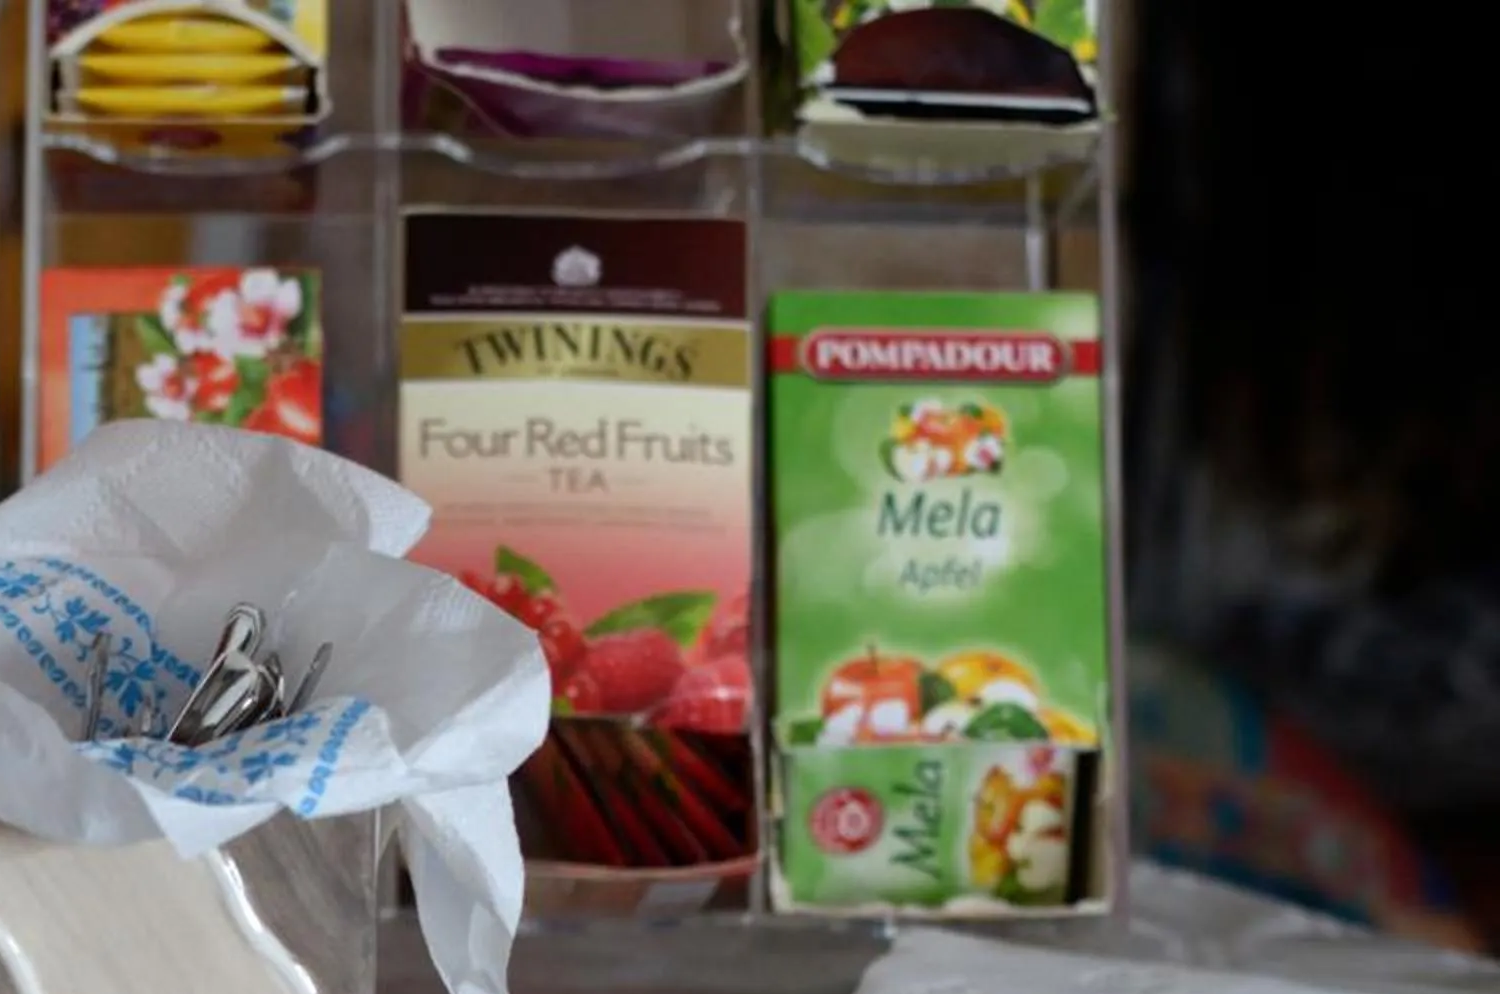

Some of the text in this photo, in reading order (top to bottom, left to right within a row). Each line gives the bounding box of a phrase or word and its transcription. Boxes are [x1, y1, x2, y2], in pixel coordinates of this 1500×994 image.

[455, 321, 701, 381] TWININGS
[816, 338, 1056, 373] POMPADOUR
[419, 416, 735, 467] Four Red Fruits
[548, 467, 609, 494] TEA
[876, 487, 1003, 539] Mela
[899, 556, 983, 595] Apfel
[889, 758, 944, 881] Mela
